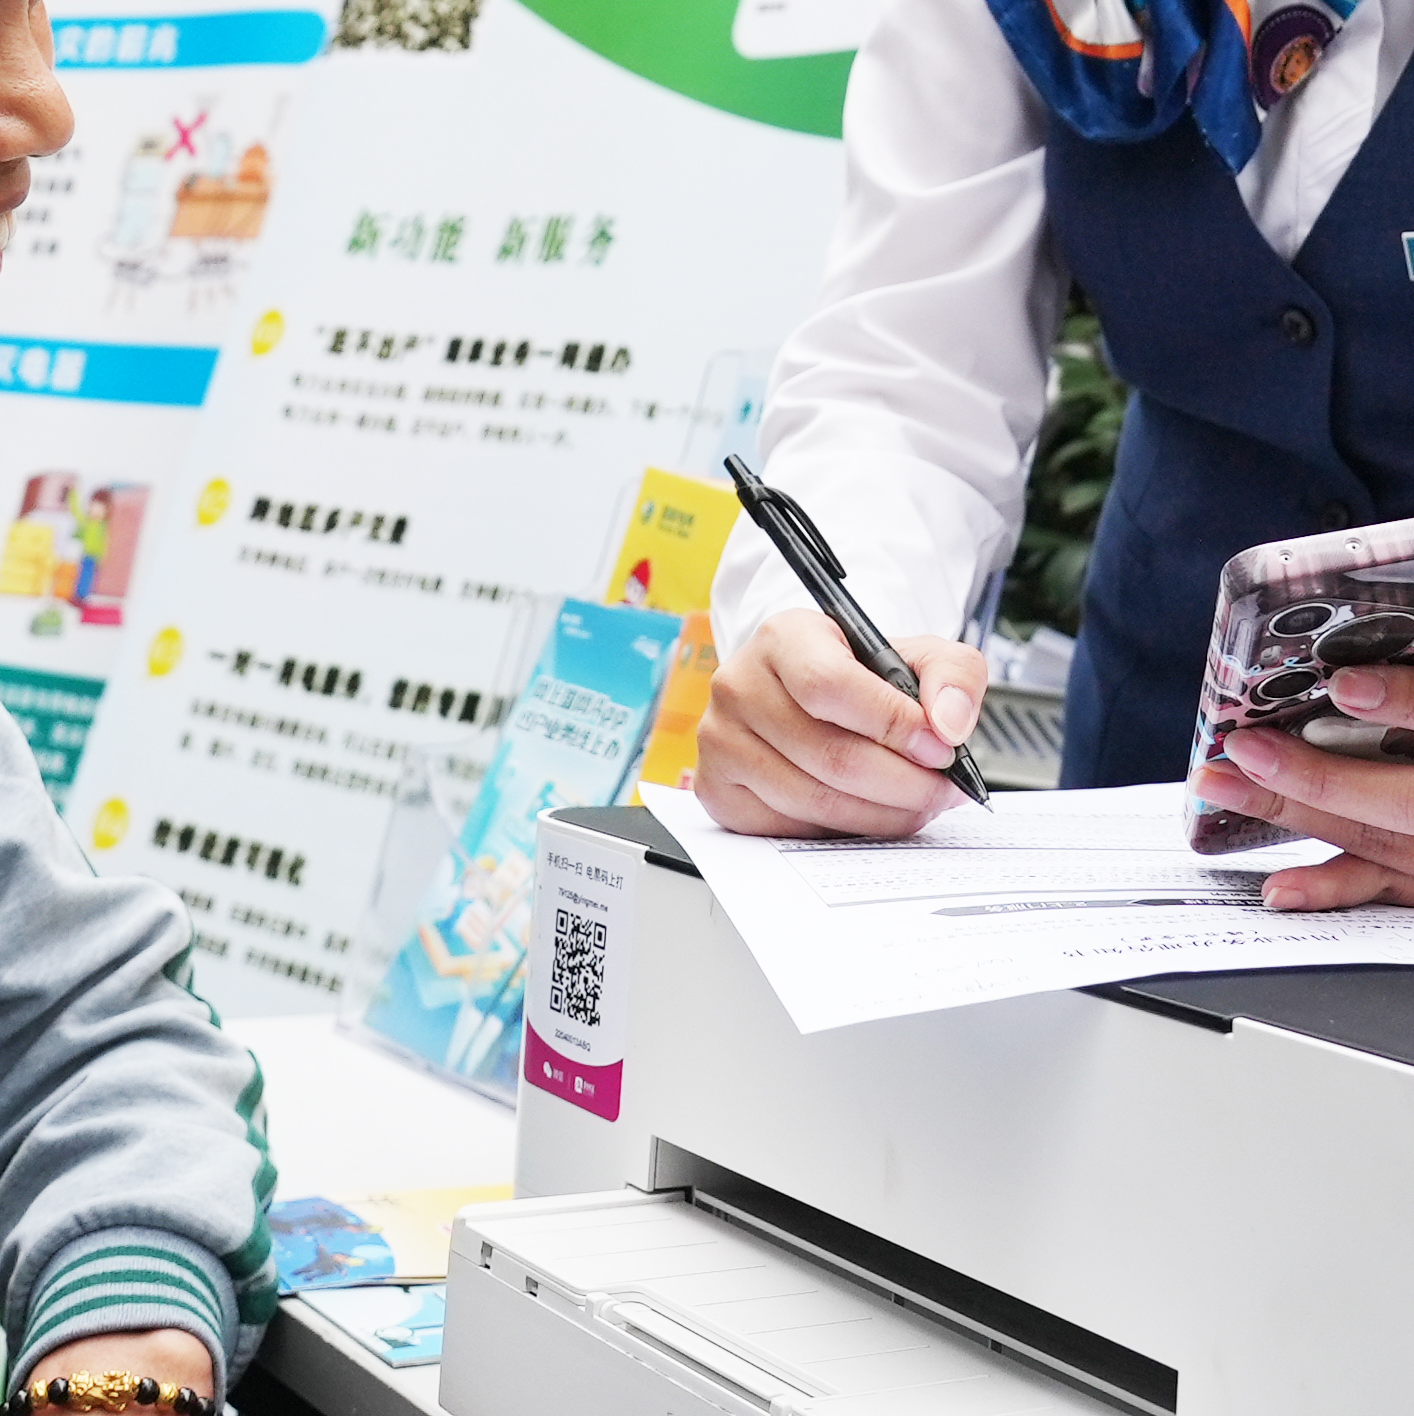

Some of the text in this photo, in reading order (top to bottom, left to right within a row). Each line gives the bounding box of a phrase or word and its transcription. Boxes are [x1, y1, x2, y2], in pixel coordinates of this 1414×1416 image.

[345, 206, 618, 268] 新功能 新服务
[547, 851, 583, 877] 手机扫一扫
